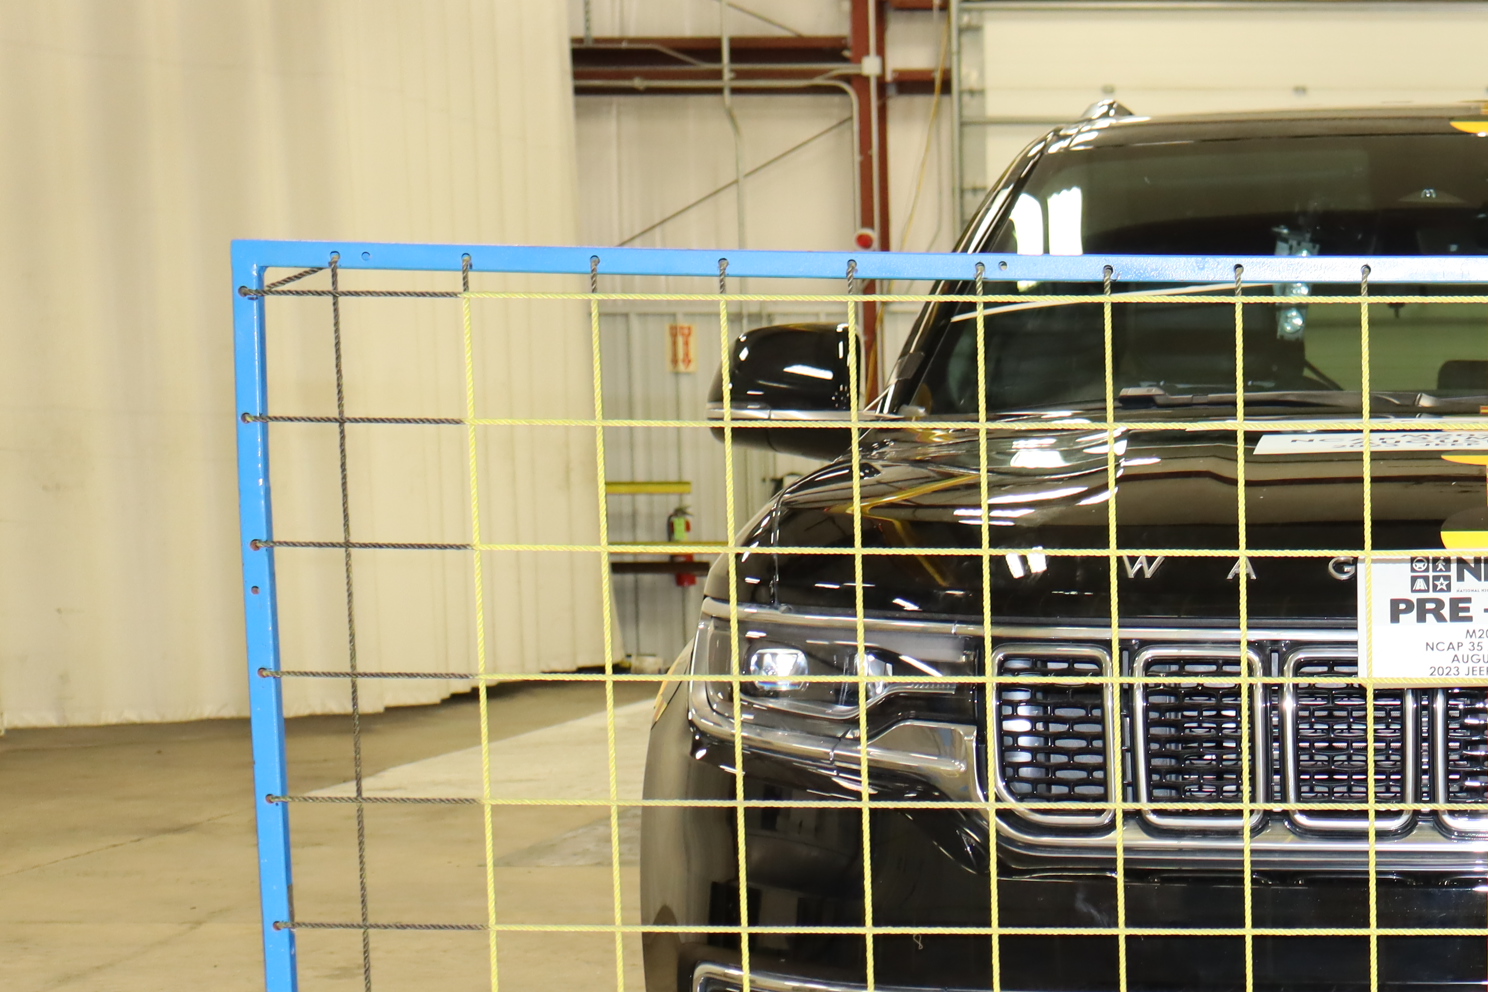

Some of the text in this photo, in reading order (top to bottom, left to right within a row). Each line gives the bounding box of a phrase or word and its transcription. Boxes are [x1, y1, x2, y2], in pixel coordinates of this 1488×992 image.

[1389, 597, 1474, 624] PRE
[1425, 641, 1464, 652] NCAP
[1468, 641, 1484, 652] 35
[1429, 666, 1461, 677] 2023
